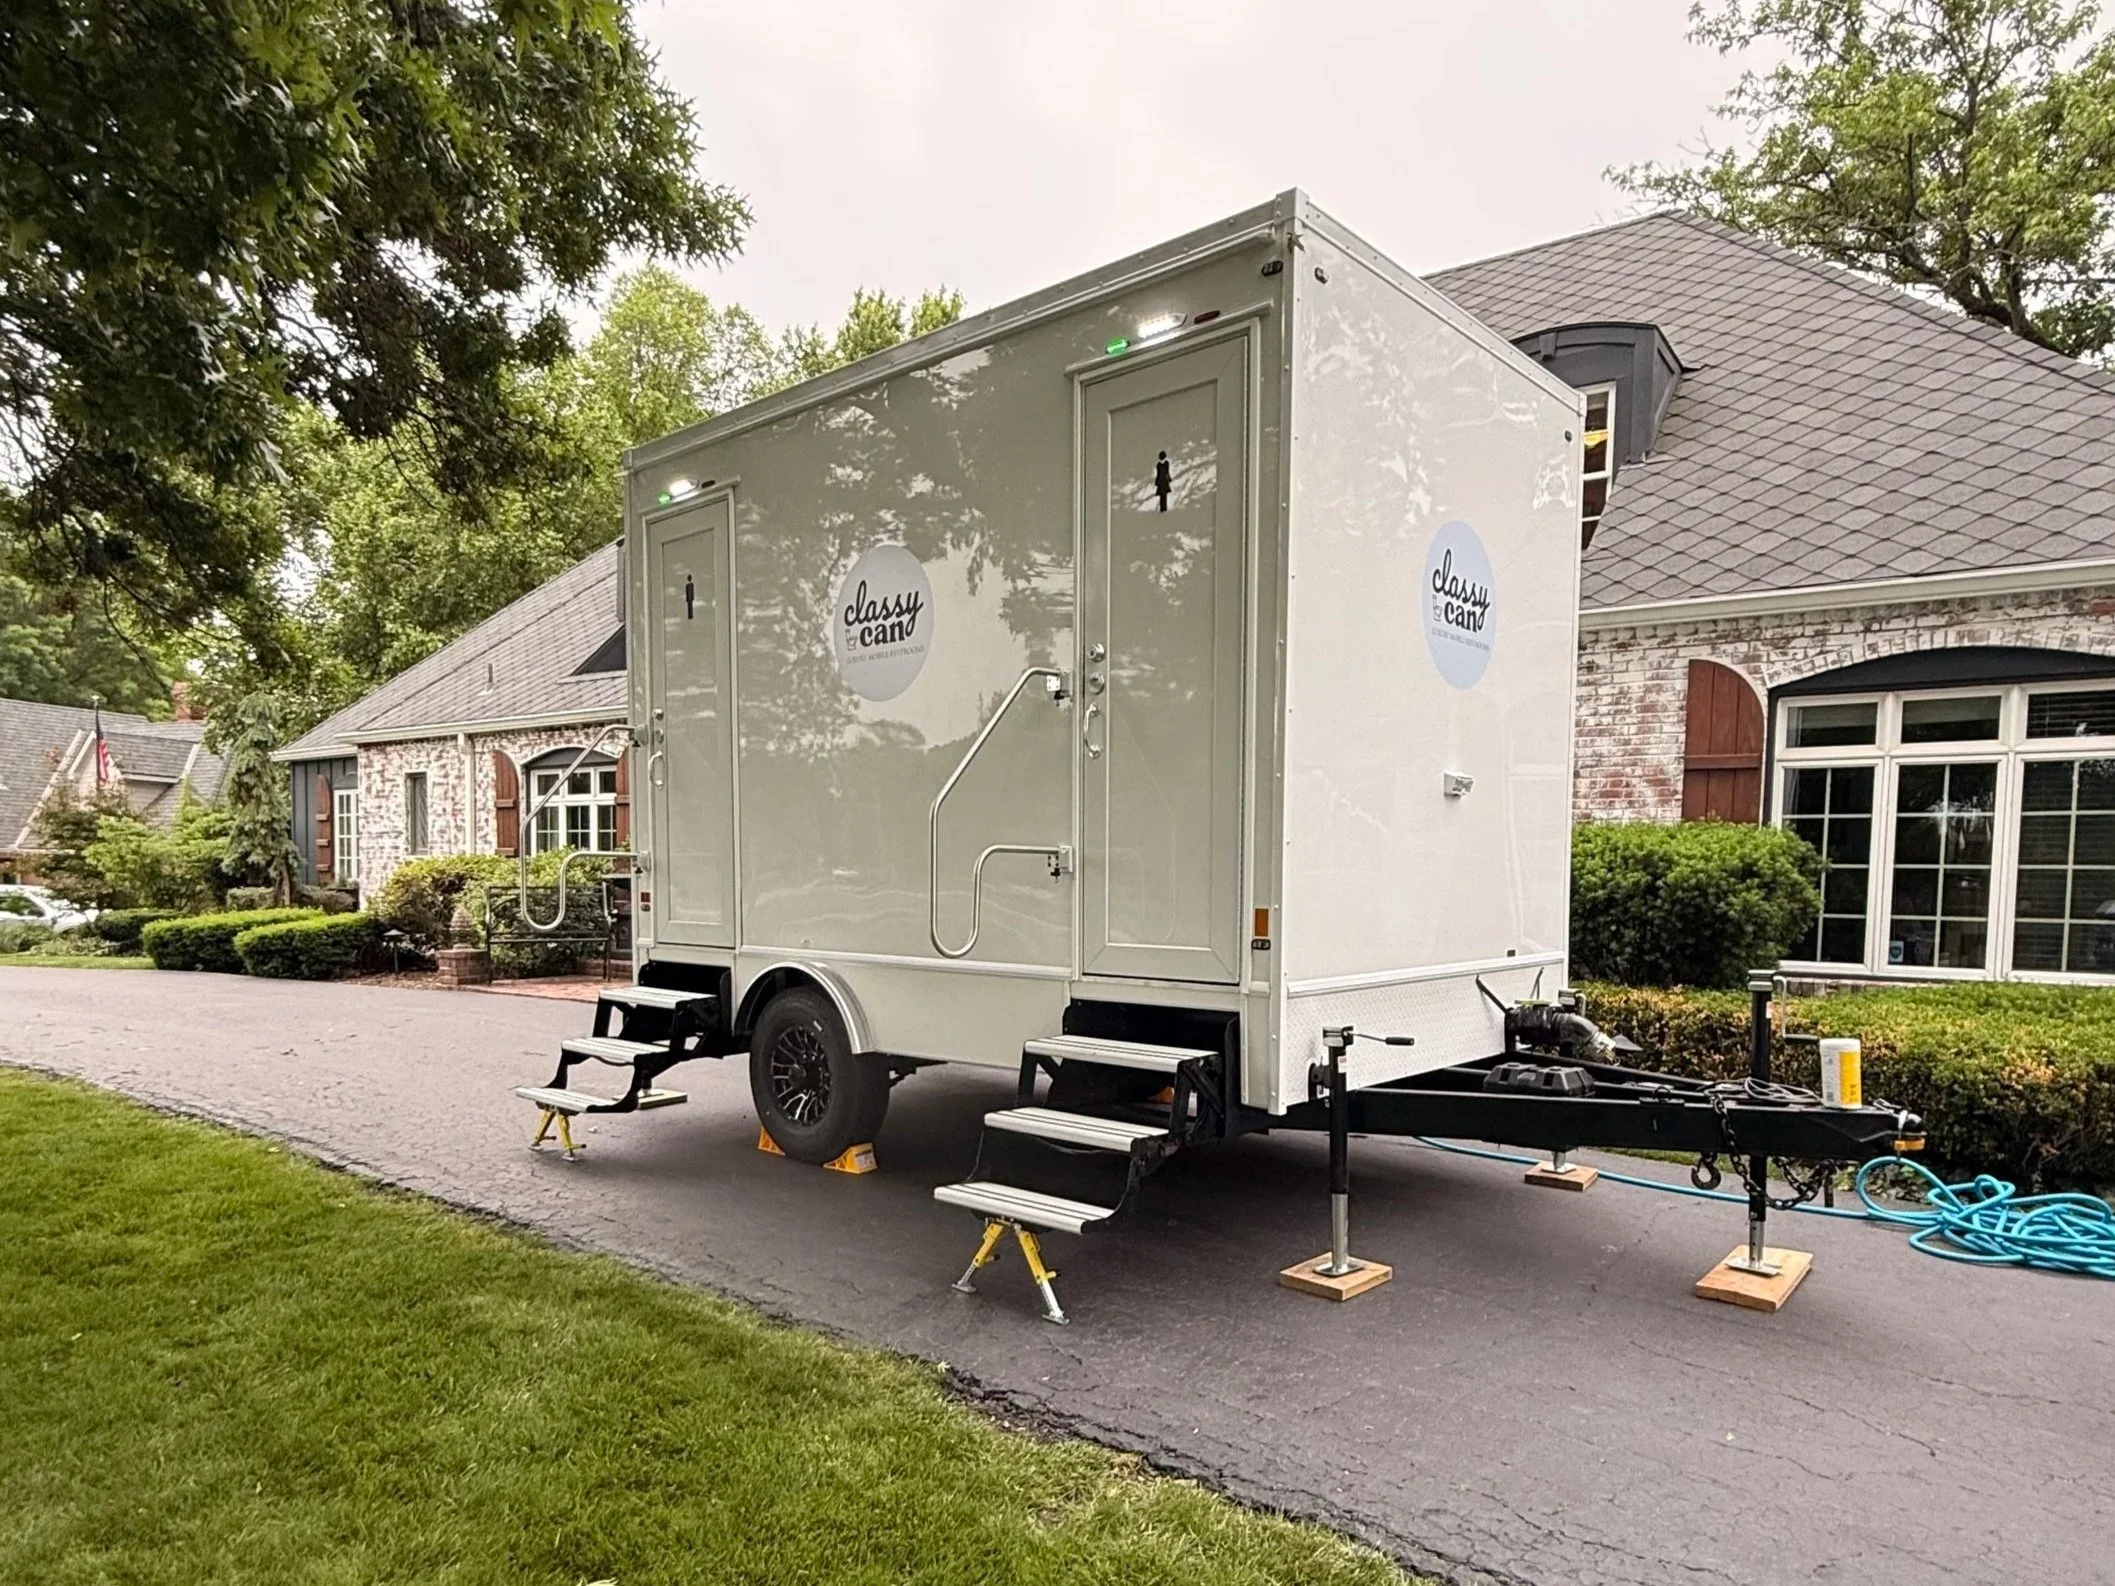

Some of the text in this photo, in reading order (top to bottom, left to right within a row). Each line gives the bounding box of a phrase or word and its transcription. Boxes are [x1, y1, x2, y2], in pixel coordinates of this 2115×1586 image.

[844, 580, 924, 637] classy
[1432, 548, 1490, 630] classy
[860, 620, 906, 647] can
[1444, 601, 1478, 633] can
